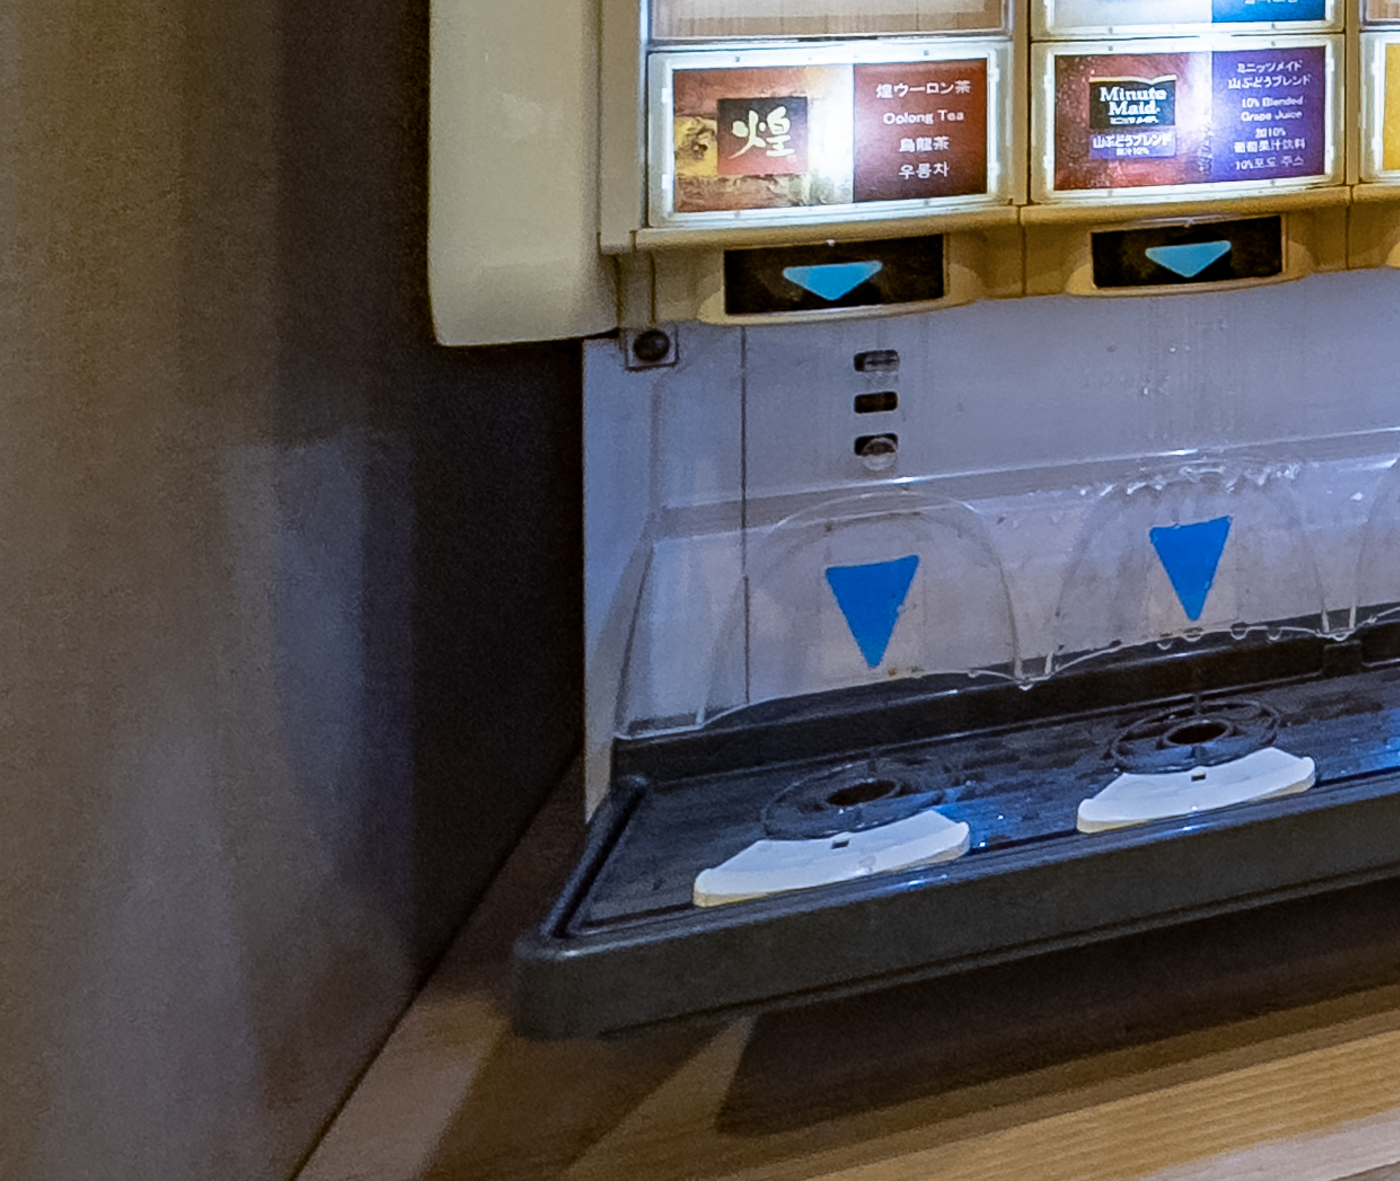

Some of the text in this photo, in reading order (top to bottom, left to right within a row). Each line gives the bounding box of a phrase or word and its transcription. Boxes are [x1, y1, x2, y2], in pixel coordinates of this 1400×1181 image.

[1100, 86, 1168, 102] Minute
[883, 109, 964, 126] Oolong Tea
